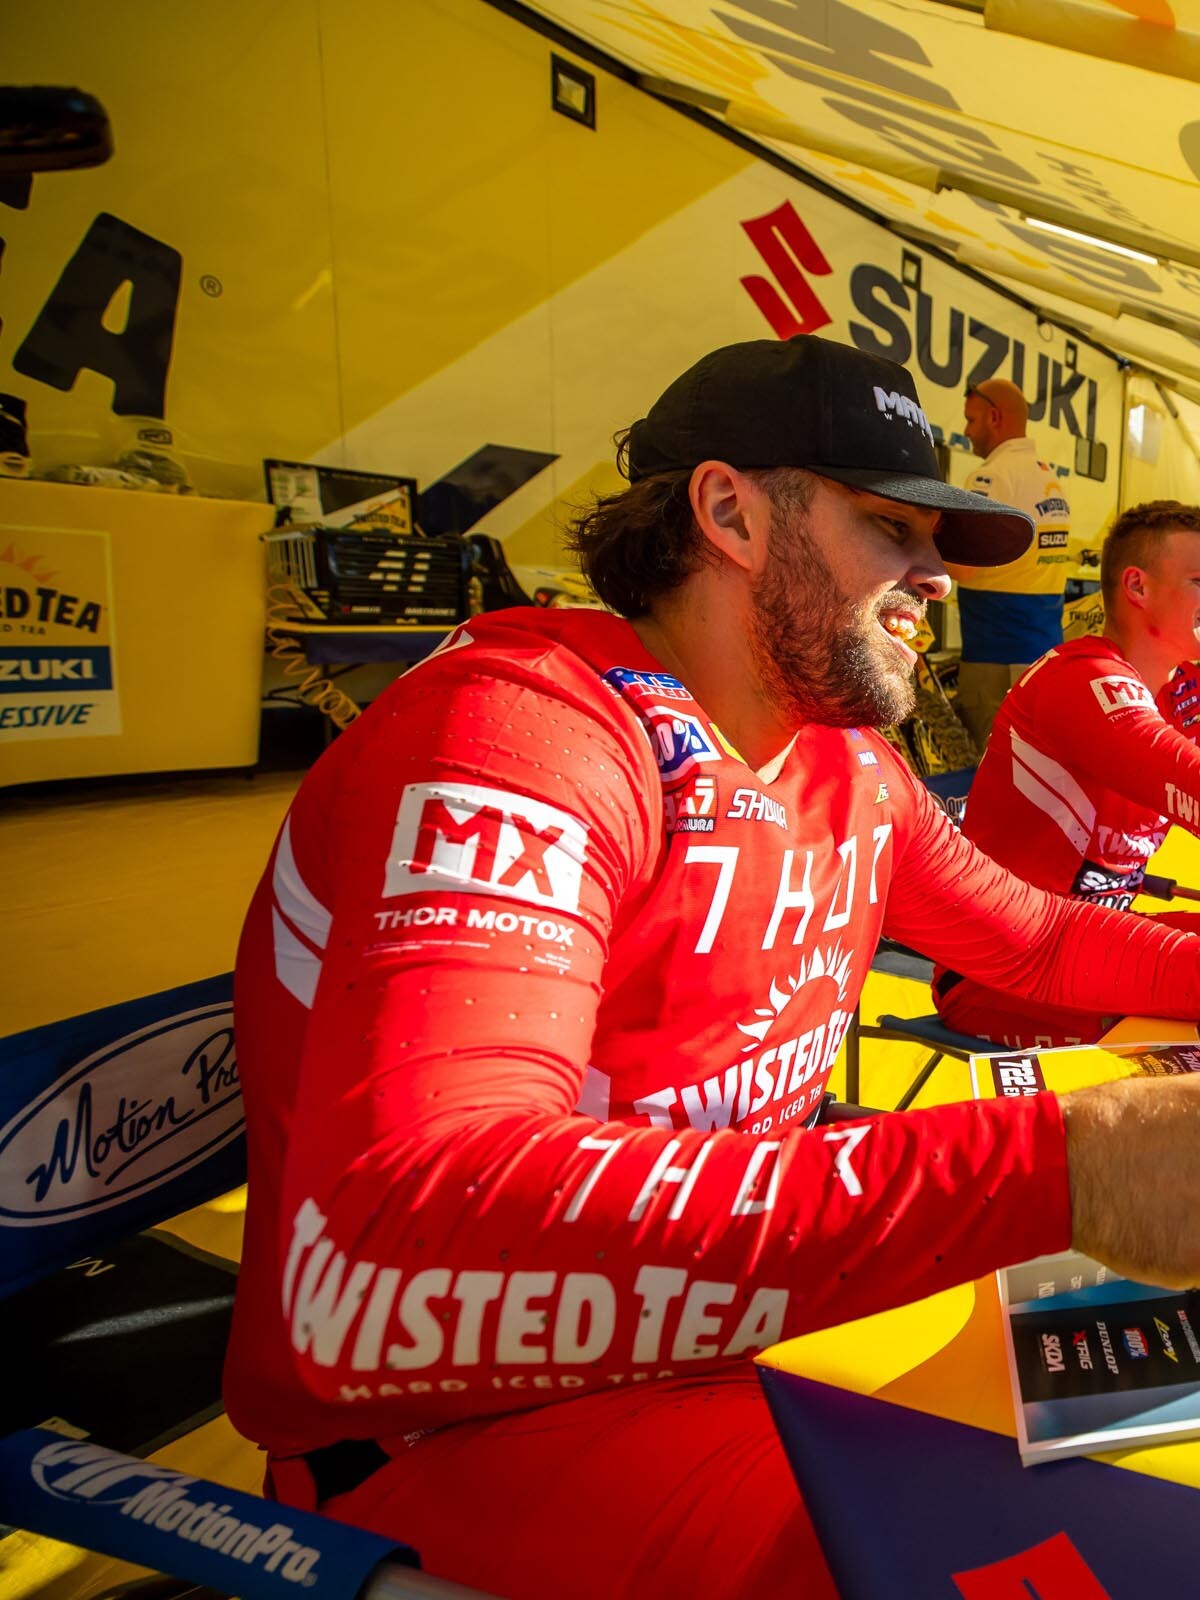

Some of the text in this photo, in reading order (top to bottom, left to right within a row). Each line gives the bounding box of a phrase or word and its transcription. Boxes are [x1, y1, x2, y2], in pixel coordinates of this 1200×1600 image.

[848, 263, 1098, 439] SUZUKI
[36, 586, 102, 634] TEA
[409, 798, 565, 898] MX
[726, 787, 789, 832] SHOWA
[373, 906, 576, 946] THOR MOTOX
[632, 1022, 827, 1134] TWISTED
[779, 1096, 805, 1123] ICED
[26, 1082, 196, 1203] Motion
[281, 1197, 790, 1371] TWISTED TEA
[1096, 1320, 1119, 1375] DUNLOP
[336, 1378, 467, 1402] HARD
[493, 1375, 584, 1392] ICED
[121, 1480, 322, 1584] MotionPro
